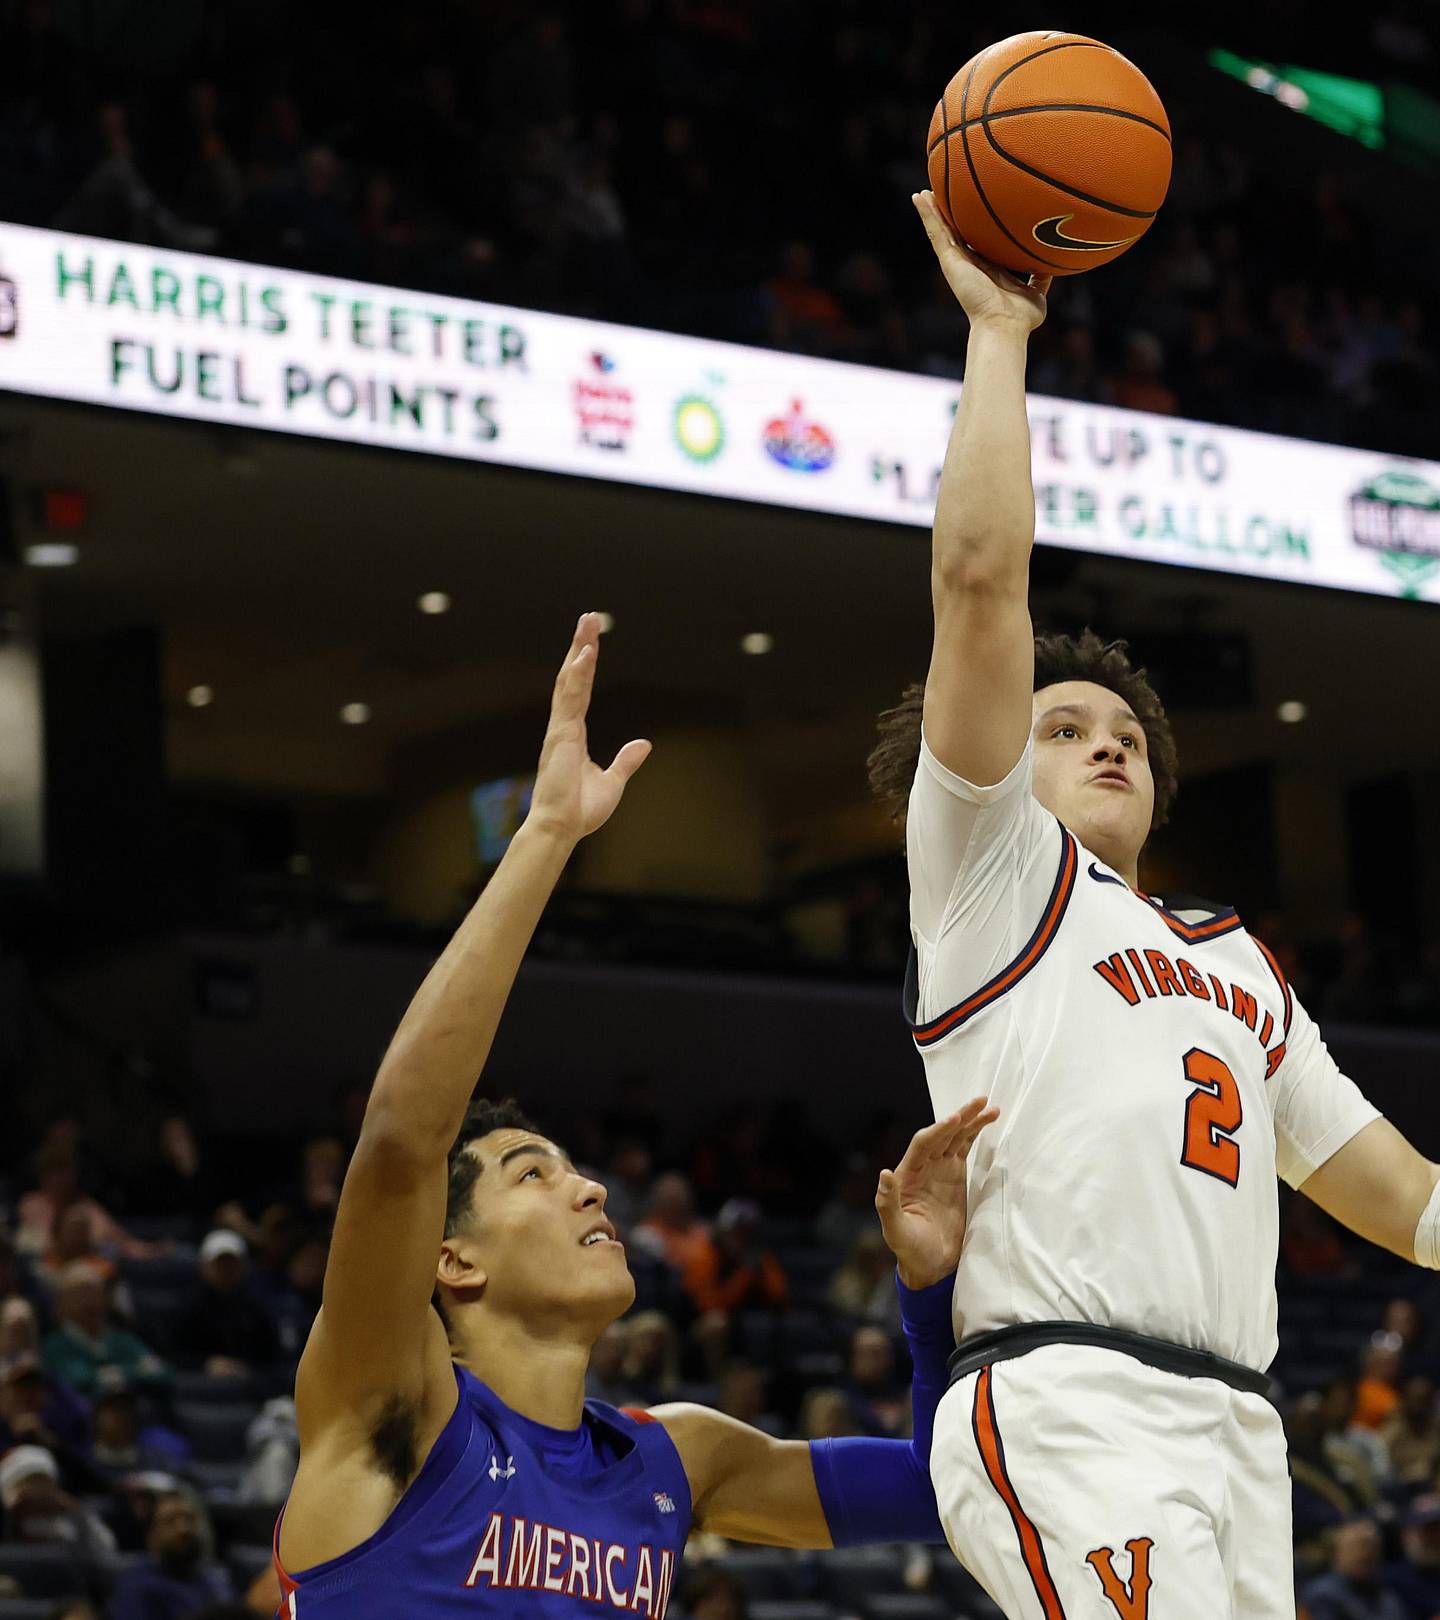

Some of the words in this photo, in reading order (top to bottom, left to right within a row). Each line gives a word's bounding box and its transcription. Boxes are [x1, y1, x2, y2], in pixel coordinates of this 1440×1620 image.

[55, 249, 287, 335] HARRIS
[312, 292, 530, 372] TEETER
[110, 337, 261, 408] FUEL
[285, 366, 500, 442] POINTS
[1086, 423, 1150, 469] UP
[1168, 435, 1229, 485] TO
[1119, 494, 1313, 563] GALLON
[1093, 948, 1286, 1080] VIRGINIA
[1180, 1047, 1242, 1189] 2
[464, 1512, 675, 1620] AMERICAN
